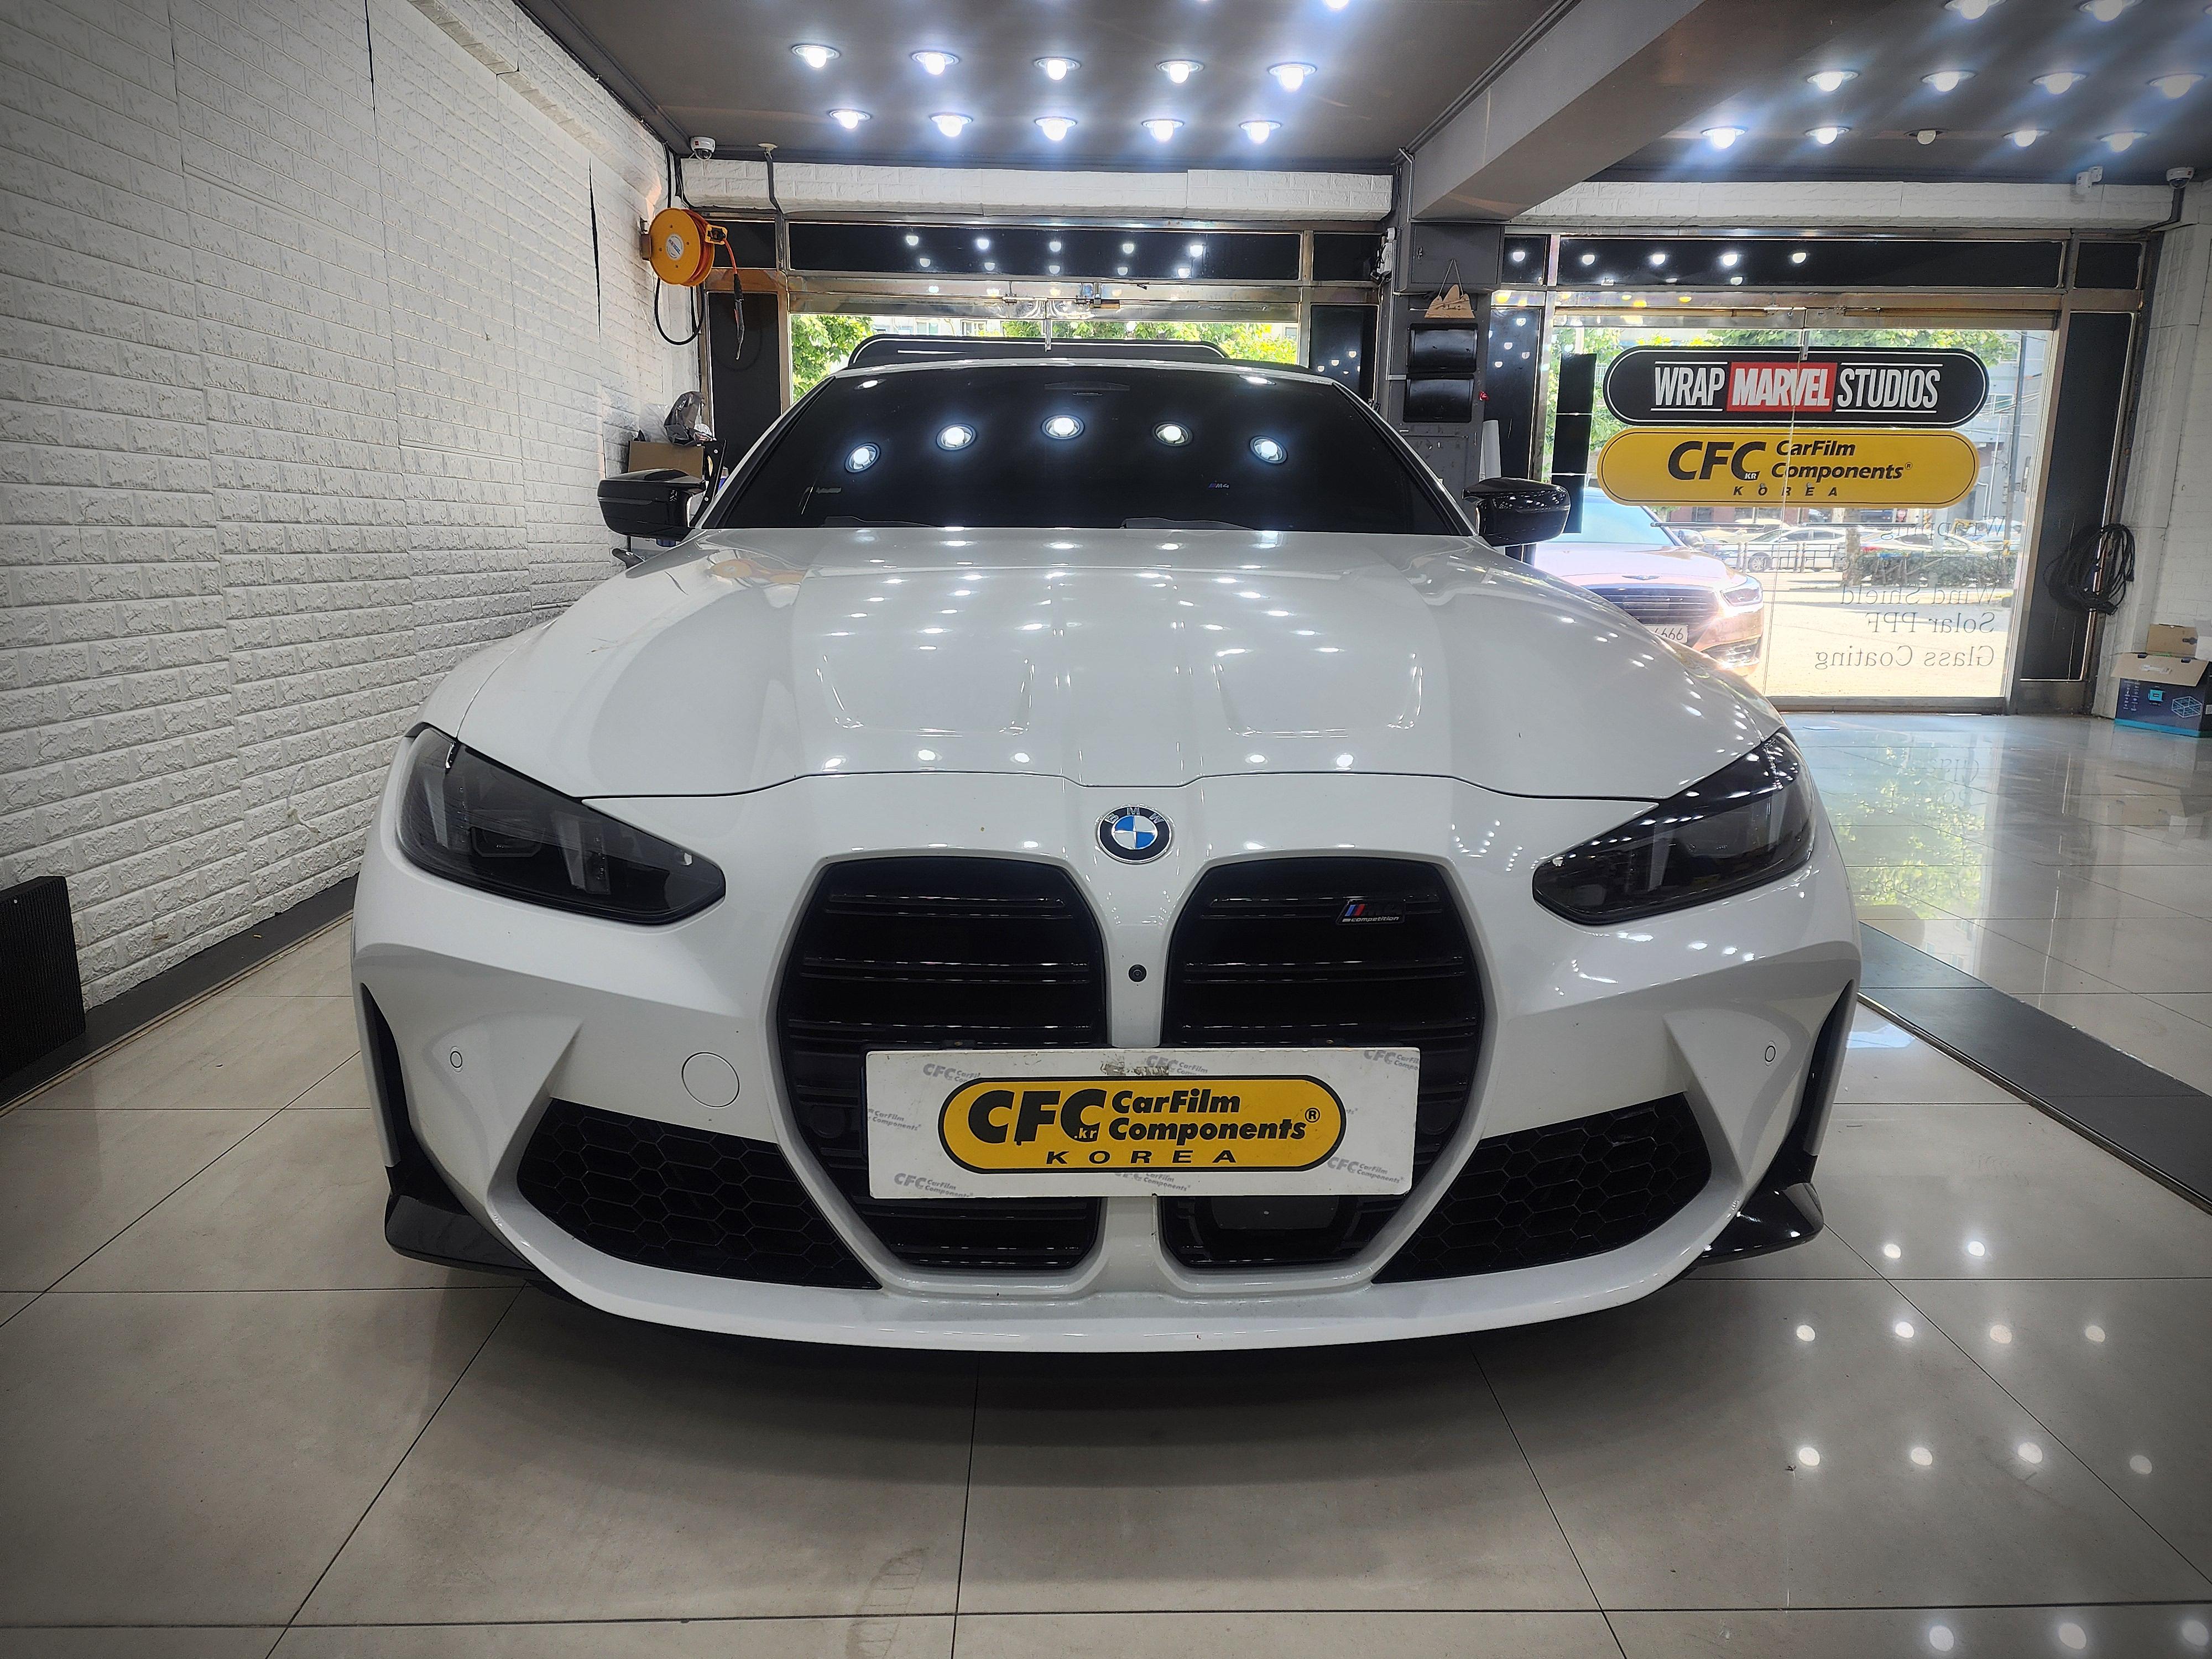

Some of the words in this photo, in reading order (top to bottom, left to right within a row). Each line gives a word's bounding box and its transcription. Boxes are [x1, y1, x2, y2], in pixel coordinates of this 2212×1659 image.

[1655, 367, 1725, 406] WRAP
[1732, 368, 1830, 406] MARVEL
[1837, 368, 1940, 408] STUDIOS
[1776, 440, 1856, 456] CarFilm
[1668, 441, 1767, 481] CFC
[1733, 486, 1838, 497] KOREA
[1104, 807, 1165, 824] BMW
[1363, 1050, 1396, 1065] CFC
[923, 1063, 956, 1081] CFC
[1112, 1088, 1241, 1114] CarFilm
[968, 1088, 1107, 1144] CFC
[1046, 1150, 1237, 1165] KOREA
[1327, 1157, 1359, 1173] CFC
[894, 1172, 927, 1190] CFC
